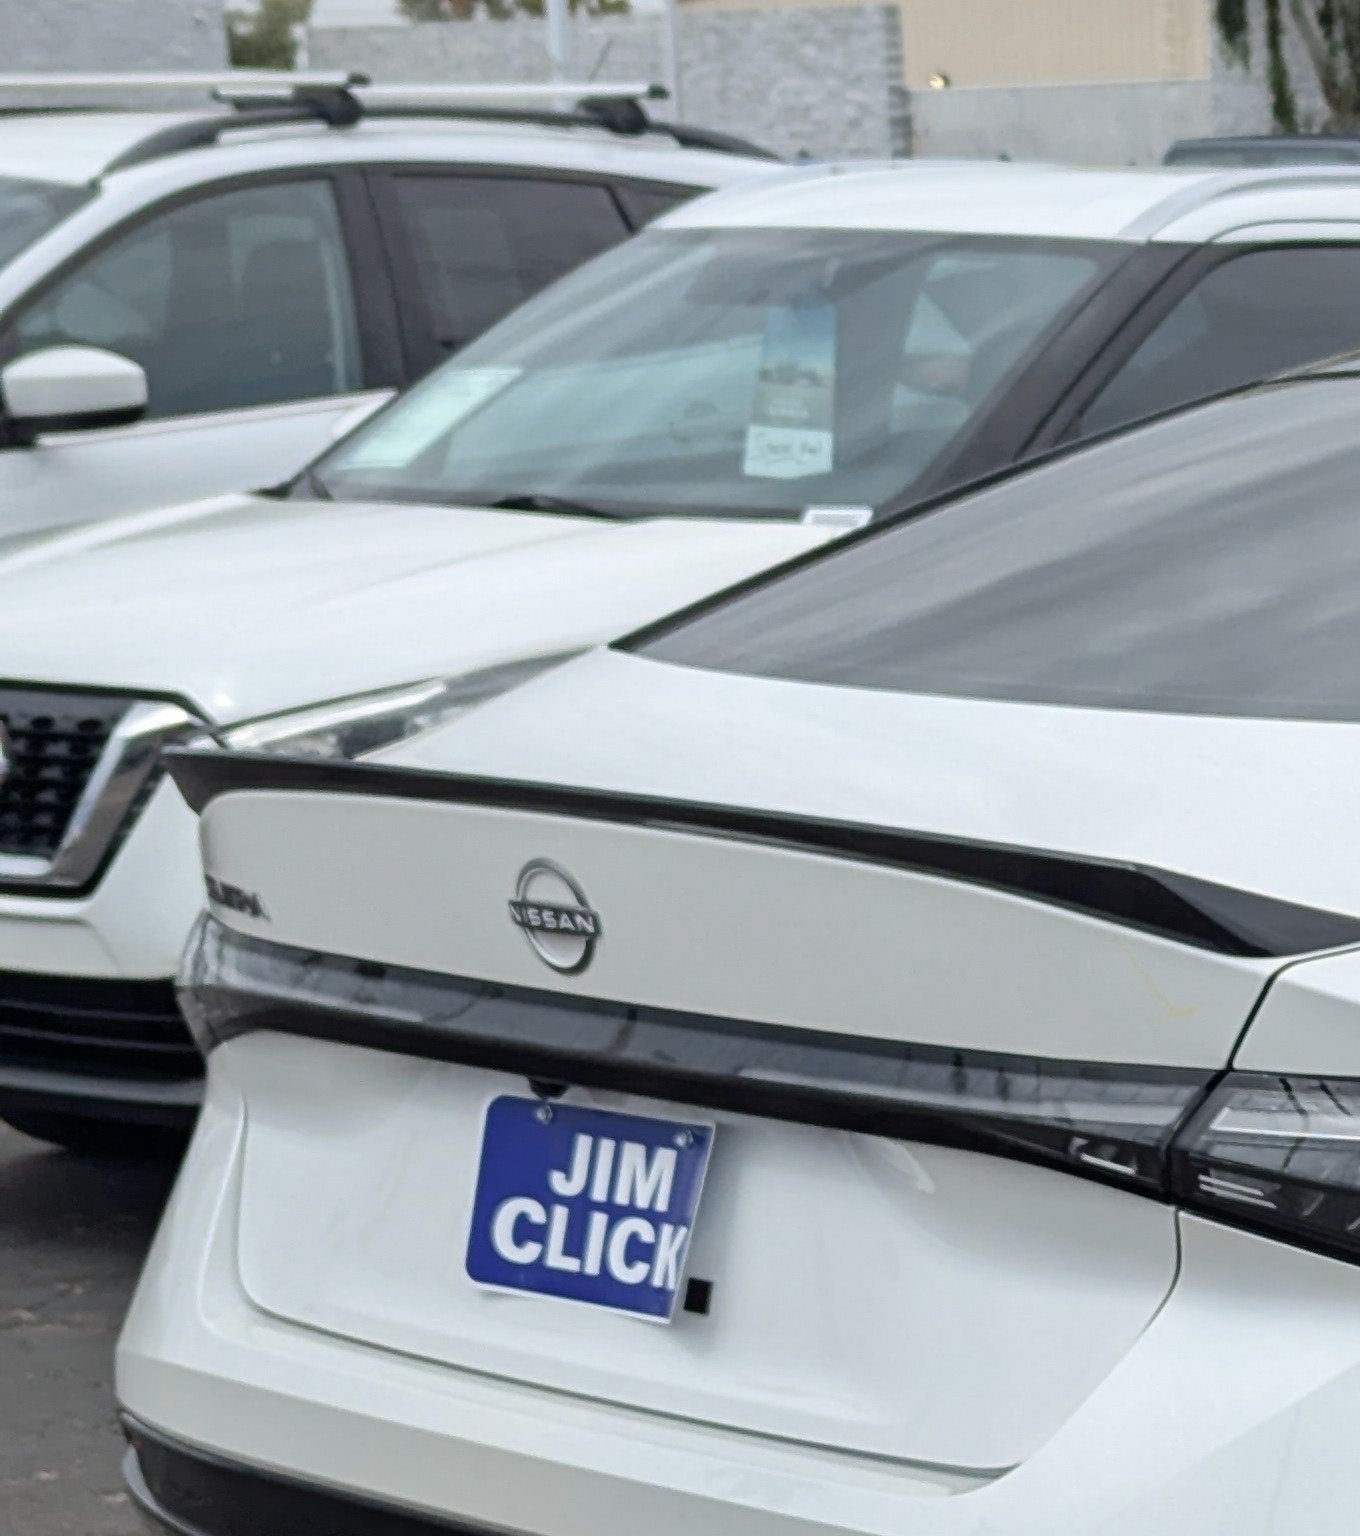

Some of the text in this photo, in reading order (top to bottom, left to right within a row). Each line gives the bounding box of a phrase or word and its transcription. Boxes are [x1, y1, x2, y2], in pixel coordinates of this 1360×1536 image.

[508, 901, 596, 934] NISSAN
[549, 1132, 678, 1213] JIM
[490, 1196, 689, 1291] CLICK
